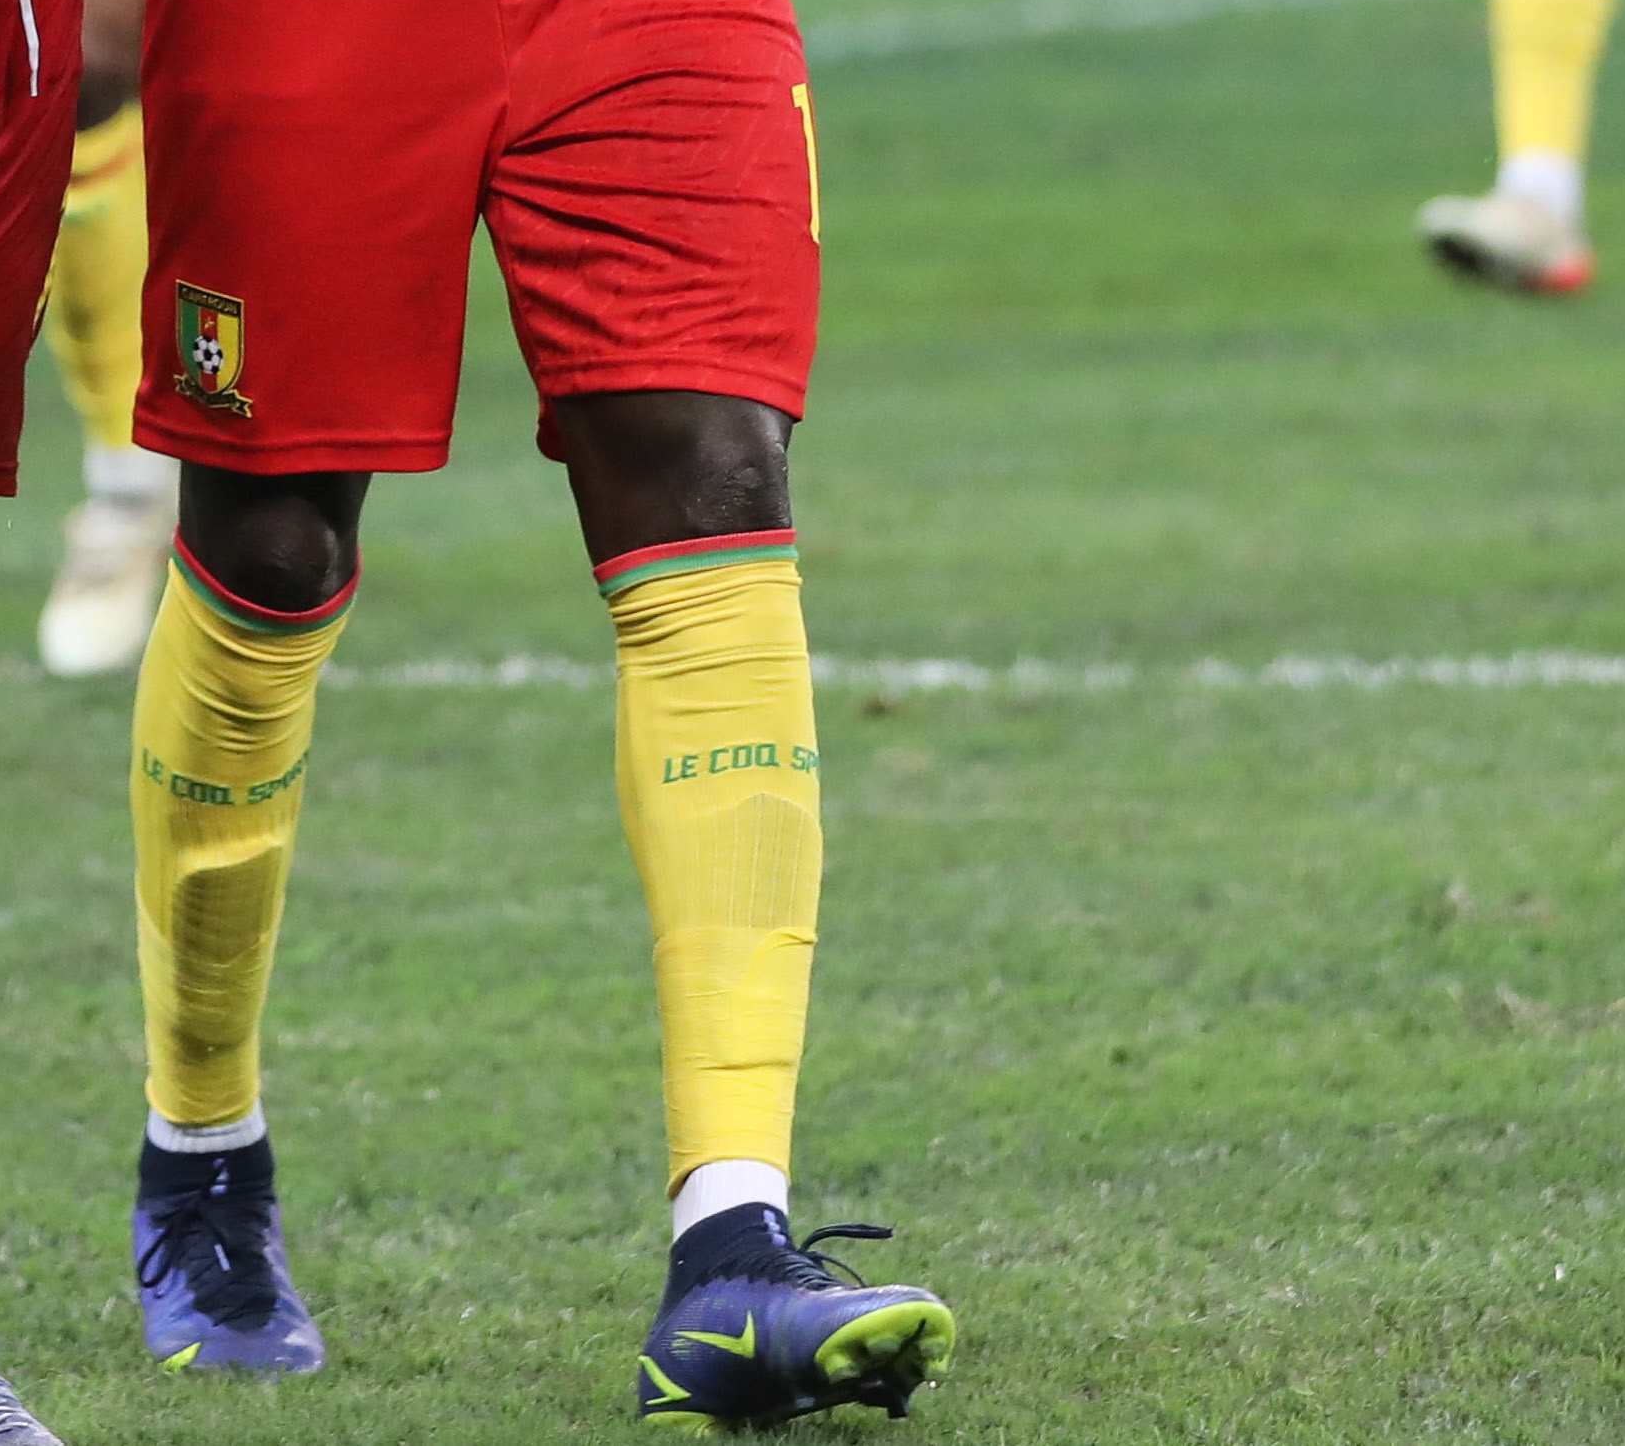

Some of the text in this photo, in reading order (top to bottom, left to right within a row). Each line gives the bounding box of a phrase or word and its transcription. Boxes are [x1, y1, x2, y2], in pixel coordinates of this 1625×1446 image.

[661, 754, 699, 784] LE
[708, 742, 780, 774] COQ
[170, 771, 235, 805] COQ
